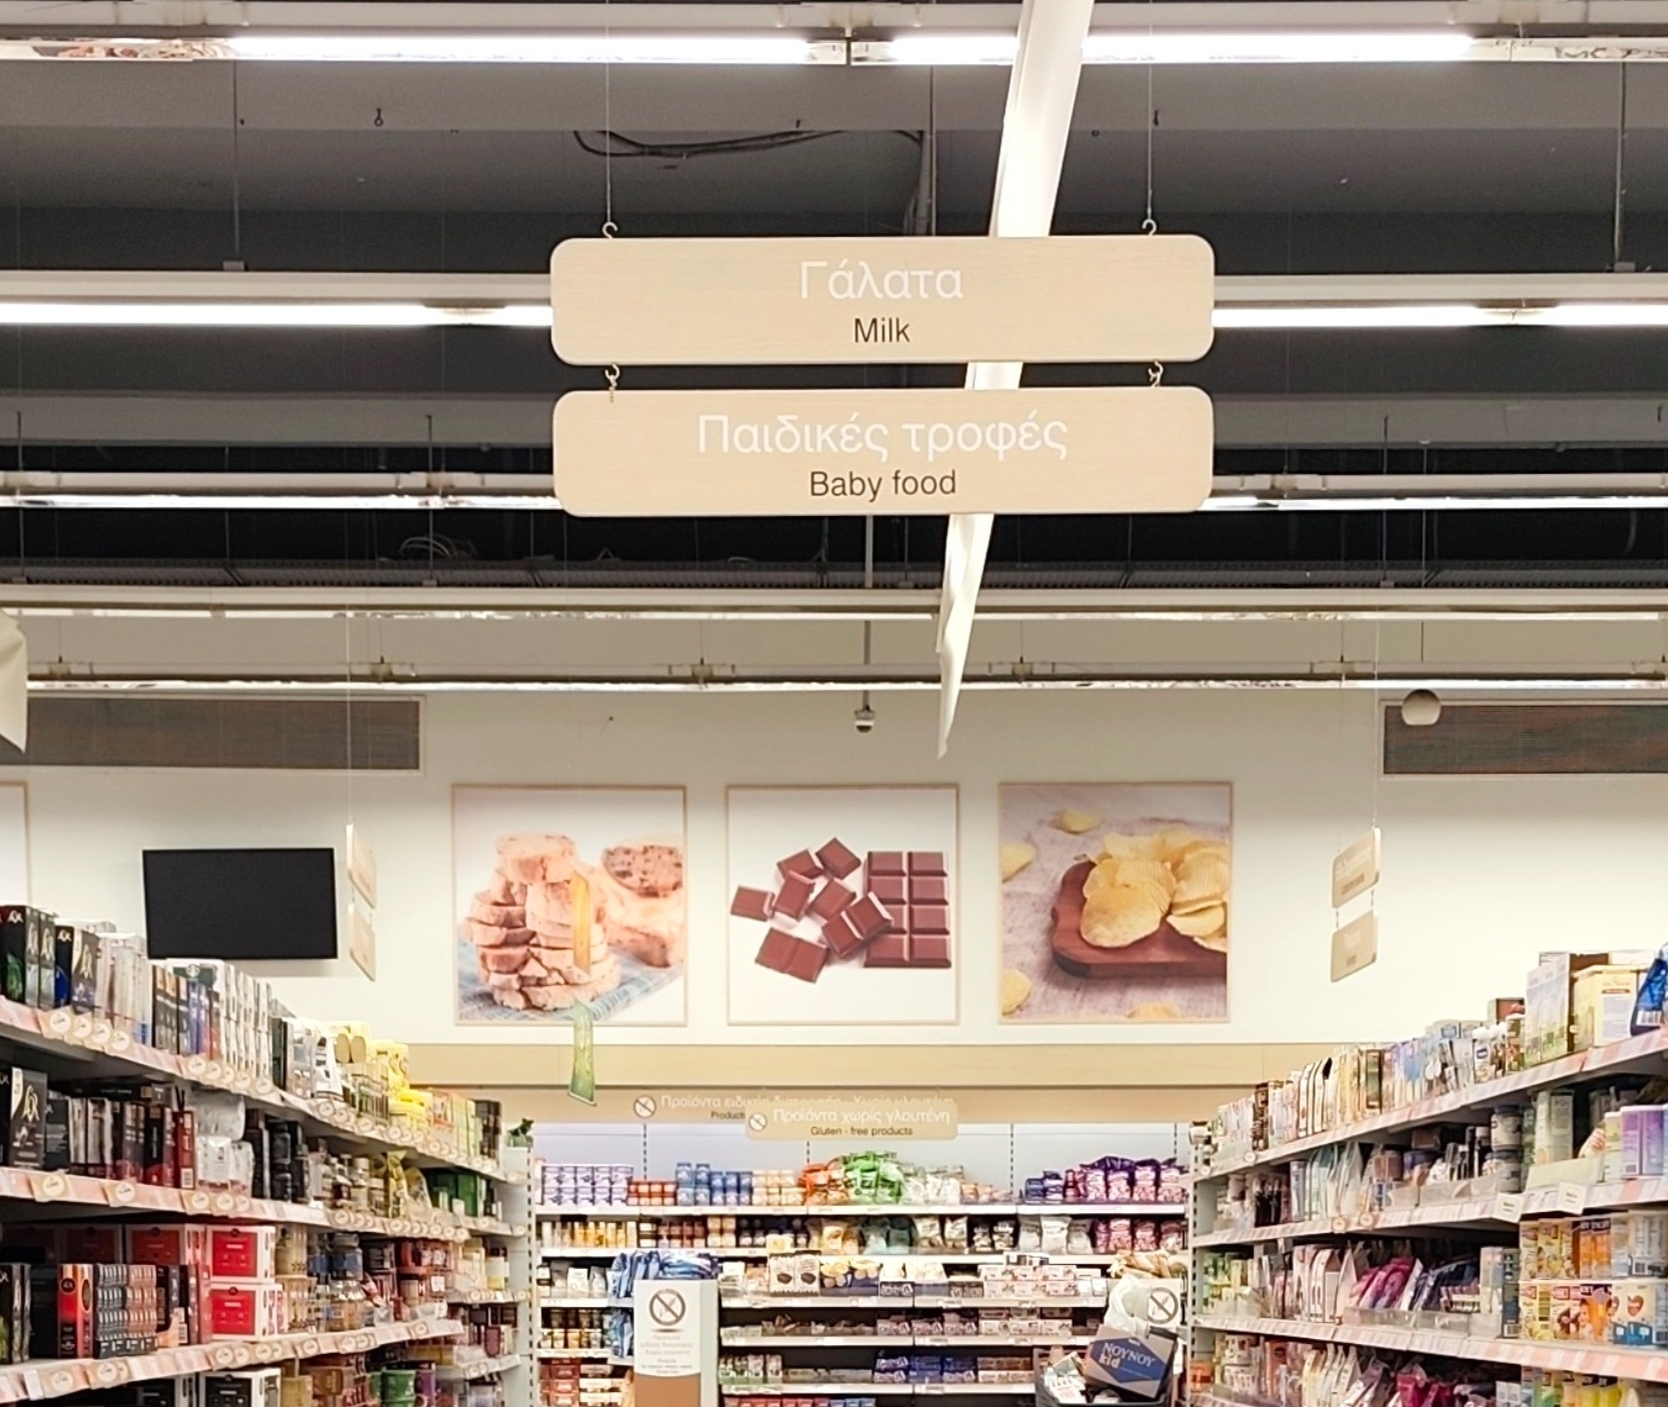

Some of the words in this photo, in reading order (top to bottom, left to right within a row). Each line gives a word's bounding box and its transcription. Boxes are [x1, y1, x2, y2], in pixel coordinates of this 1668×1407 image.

[800, 261, 963, 300] Γάλατα
[854, 317, 910, 344] Milk
[697, 416, 888, 461] Παιδικές
[903, 412, 1067, 461] τροφές
[810, 471, 882, 502] Baby
[892, 470, 956, 496] food
[811, 1127, 841, 1136] Gluten
[851, 1127, 868, 1135] free
[871, 1127, 913, 1137] products
